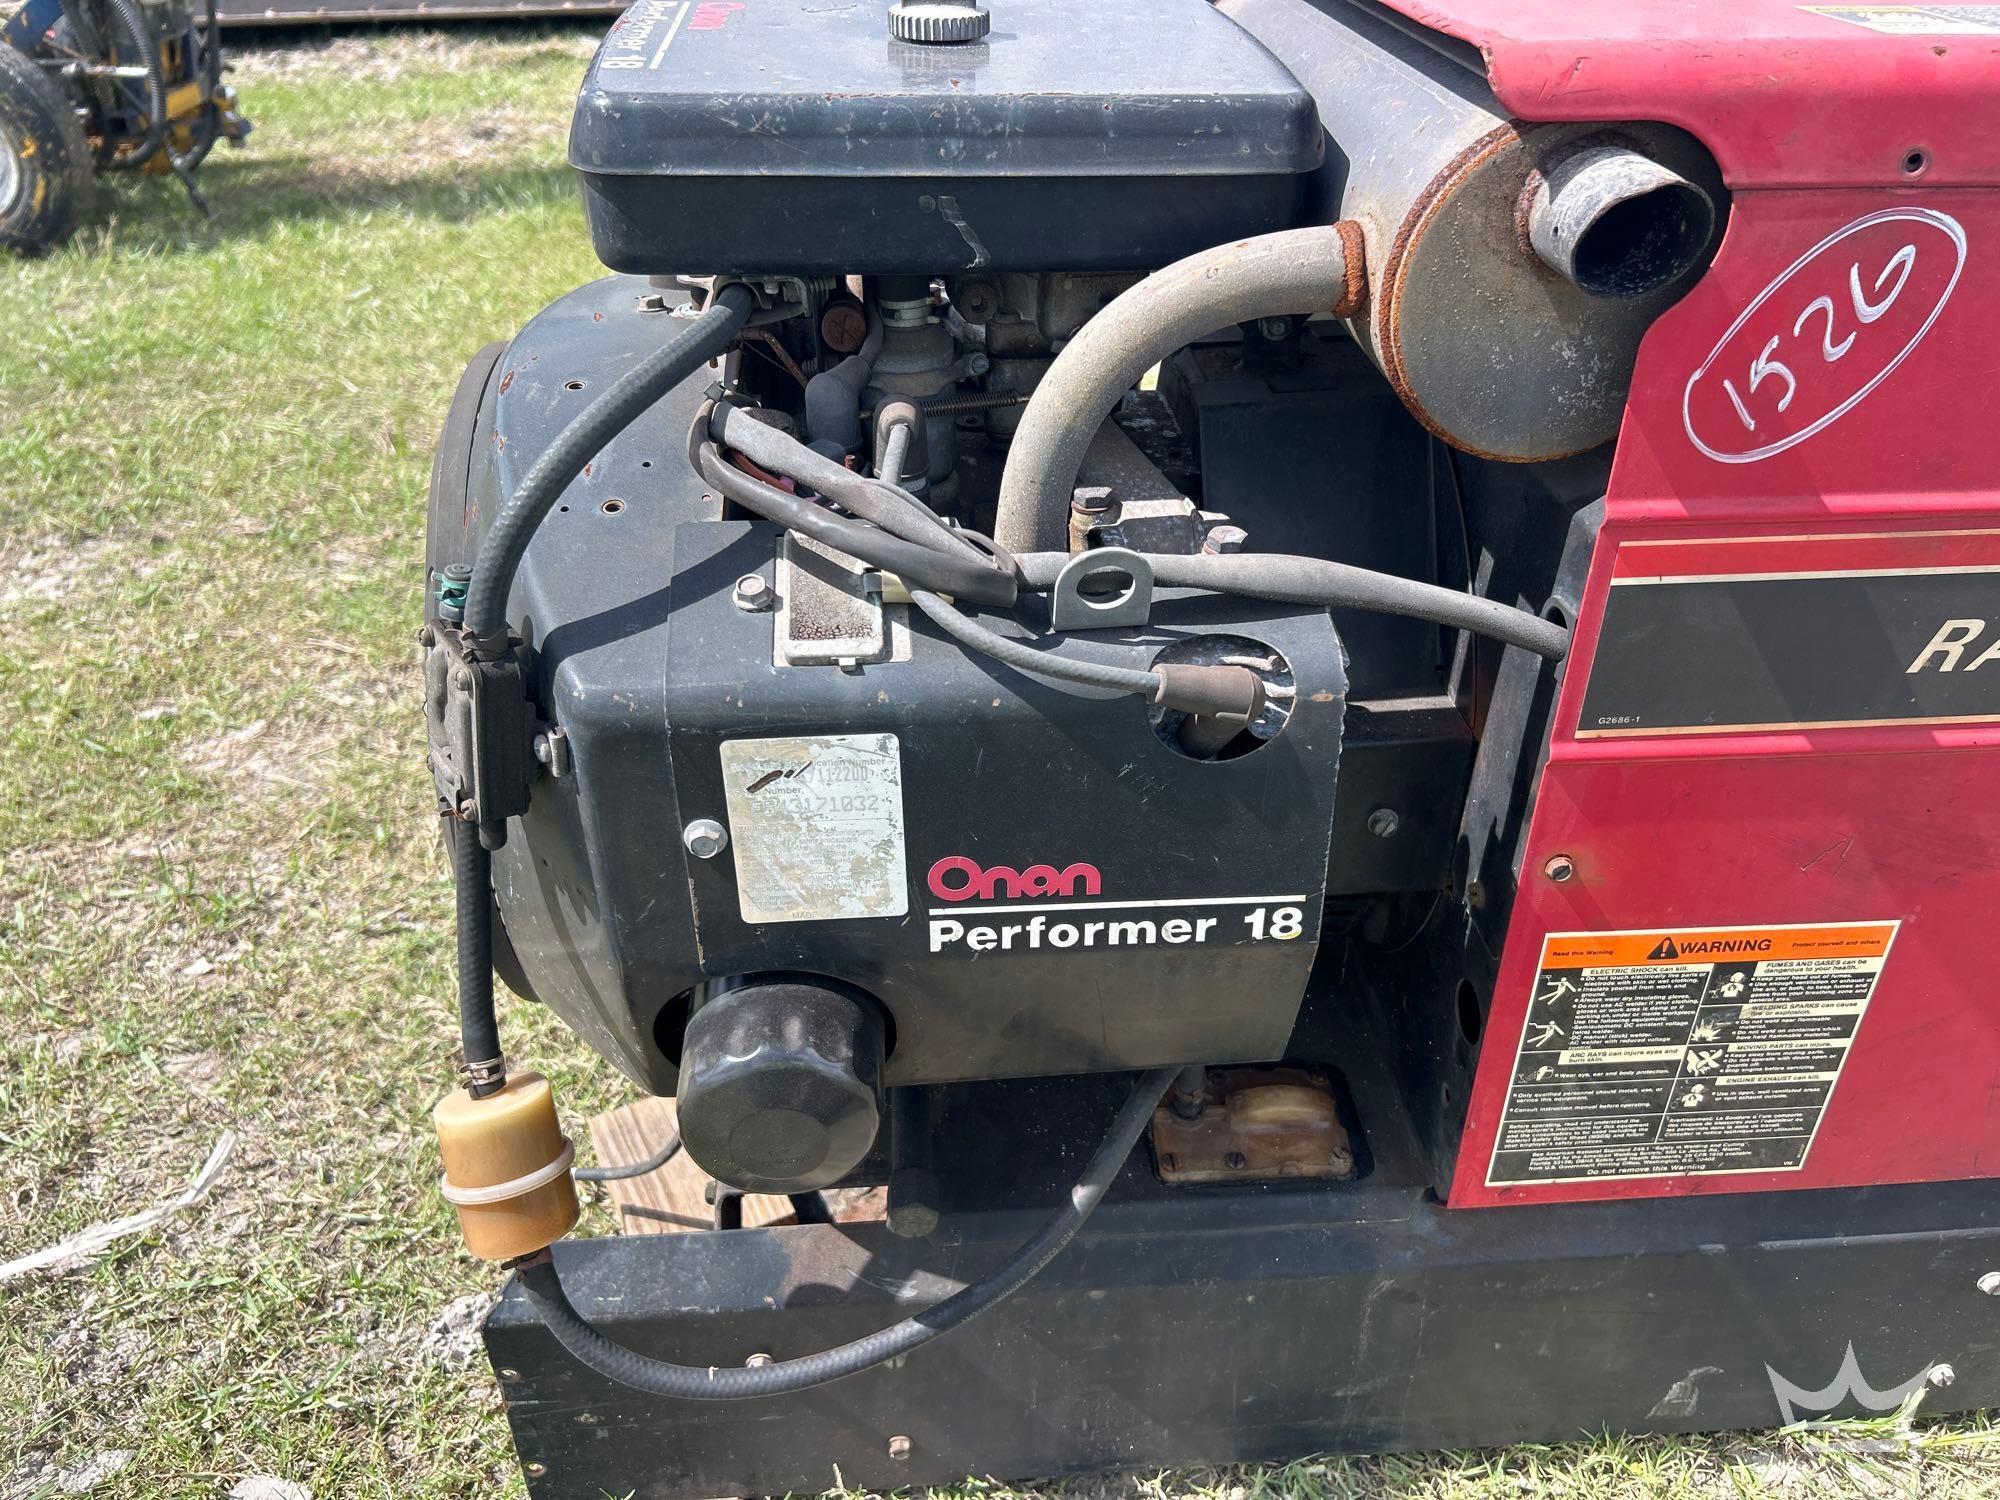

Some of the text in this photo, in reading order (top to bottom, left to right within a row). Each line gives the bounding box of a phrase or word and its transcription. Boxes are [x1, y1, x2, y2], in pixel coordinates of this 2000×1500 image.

[688, 1, 746, 31] Onan
[600, 54, 647, 69] 18
[1723, 244, 1916, 432] 1526
[1598, 716, 1641, 725] G2686-1
[767, 786, 802, 795] Number
[927, 855, 1102, 902] Onan
[929, 907, 1303, 953] Performer 18
[1677, 939, 1772, 953] WARNING
[1669, 1163, 1706, 1171] Warning
